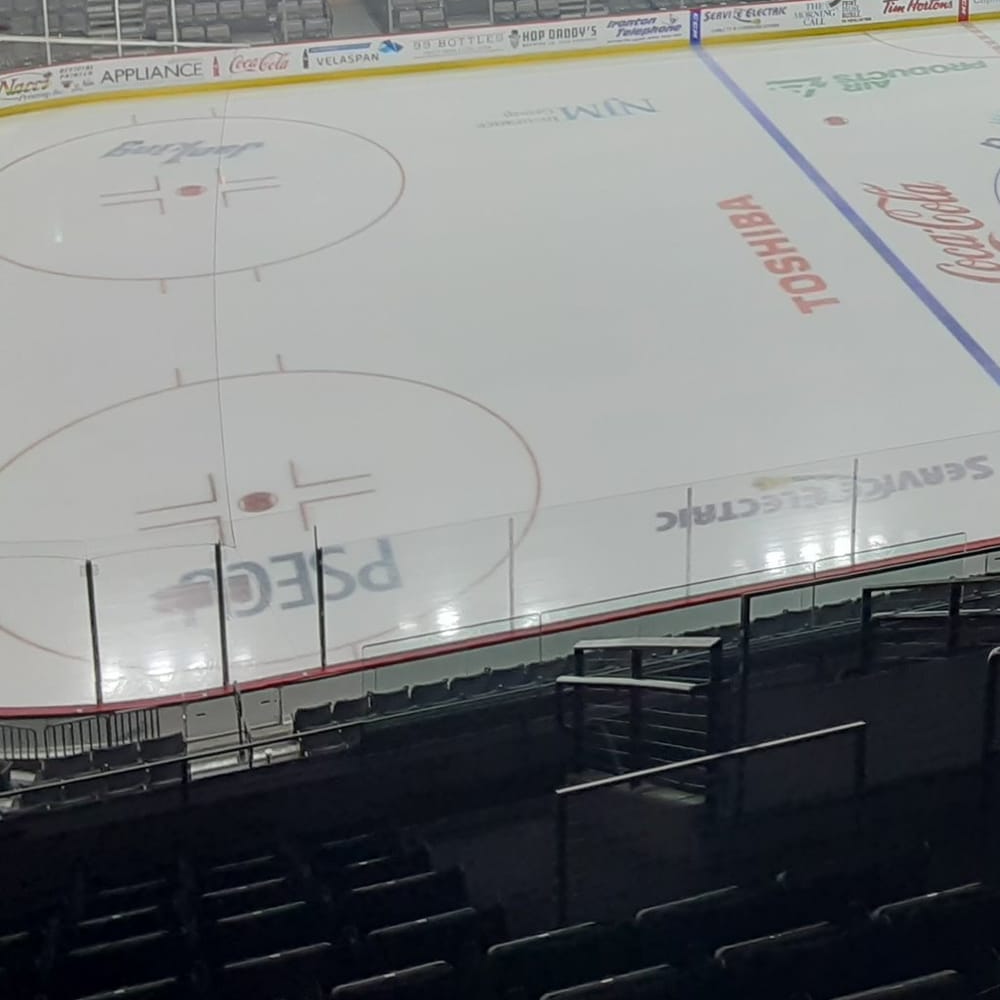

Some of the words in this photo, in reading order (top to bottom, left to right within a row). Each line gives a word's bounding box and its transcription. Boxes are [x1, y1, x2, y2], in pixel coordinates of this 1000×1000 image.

[746, 6, 787, 18] ELECTRIC
[883, 0, 907, 14] Tim
[522, 30, 545, 42] HOP
[548, 25, 597, 40] DADDY'S
[316, 53, 380, 67] VELASPAN
[100, 64, 203, 84] APPLIANCE
[717, 194, 841, 315] TOSHIBA
[224, 535, 403, 618] PSEG
